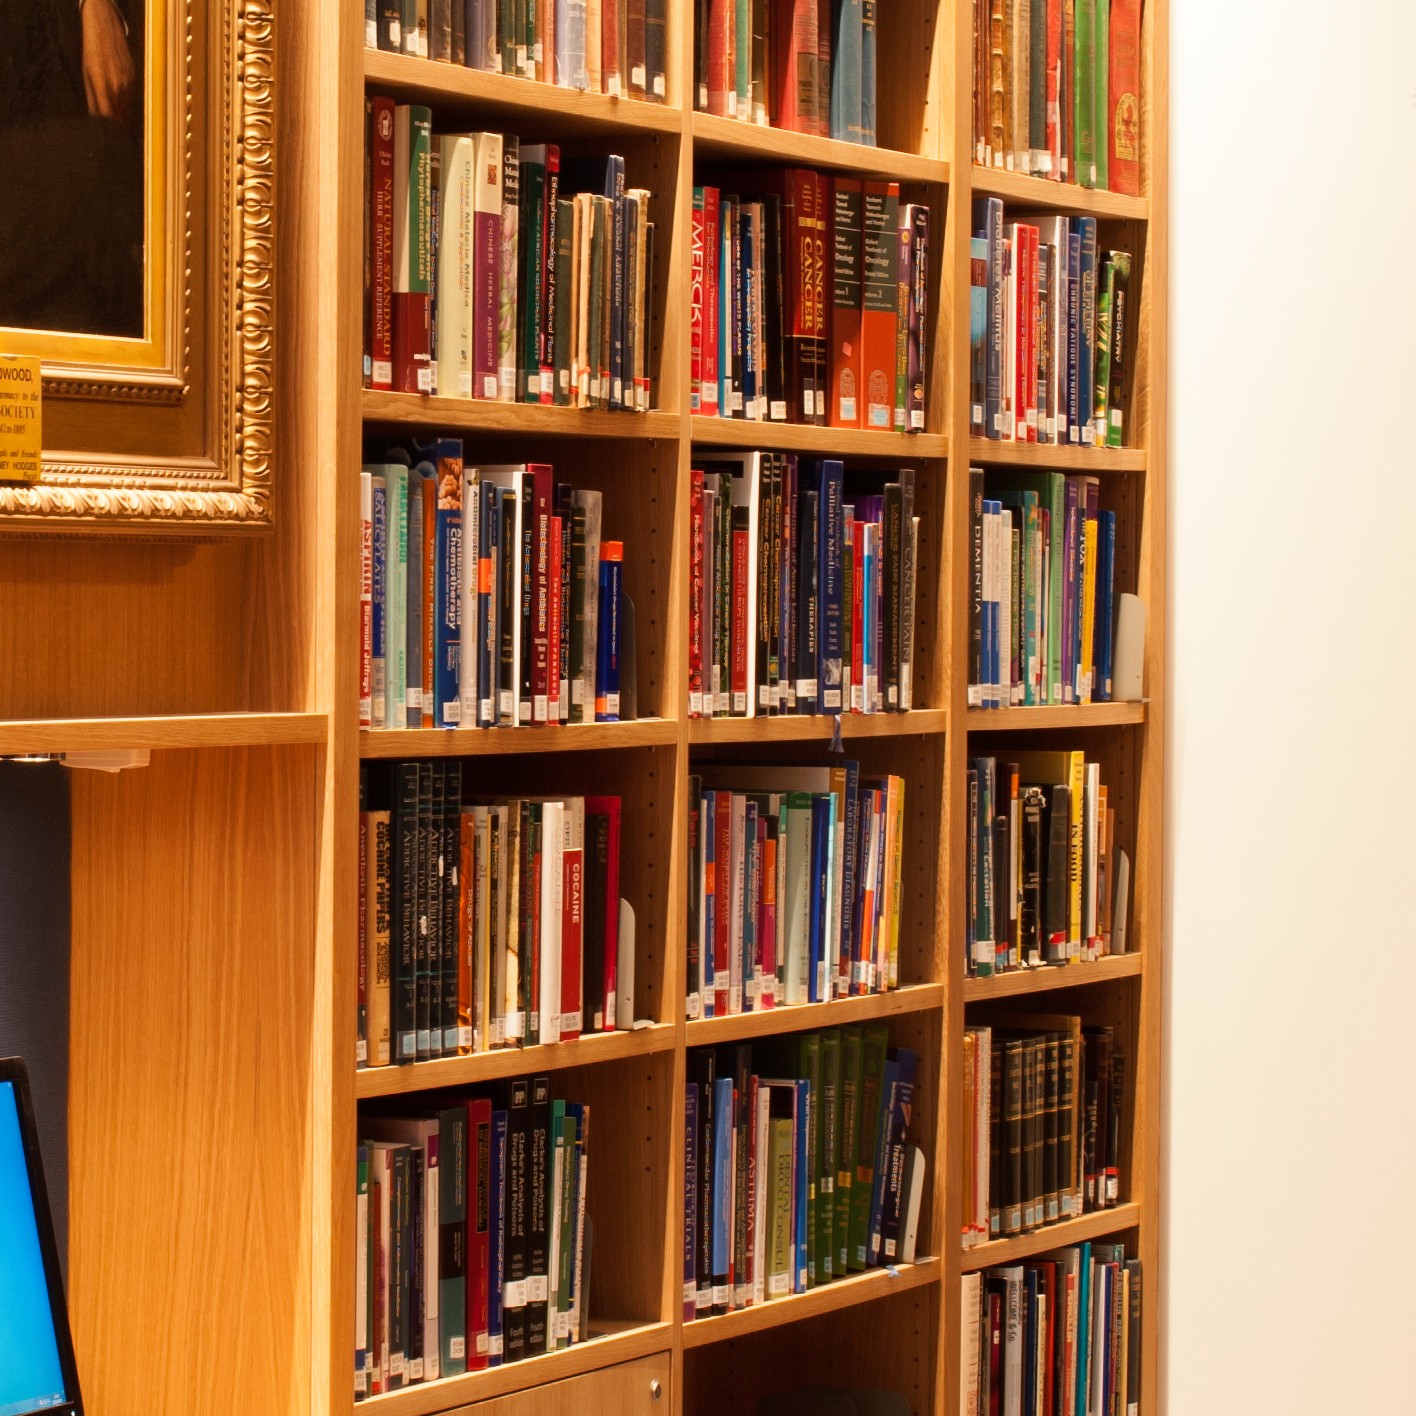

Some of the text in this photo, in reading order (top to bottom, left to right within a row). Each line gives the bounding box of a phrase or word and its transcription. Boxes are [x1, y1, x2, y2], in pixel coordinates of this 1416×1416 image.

[691, 220, 704, 322] MERCK
[804, 236, 814, 332] CANCER
[815, 239, 825, 332] CANCER
[22, 392, 29, 401] to
[13, 462, 37, 471] HODGES
[363, 605, 371, 648] Diarmuid
[572, 863, 580, 924] COCAINE
